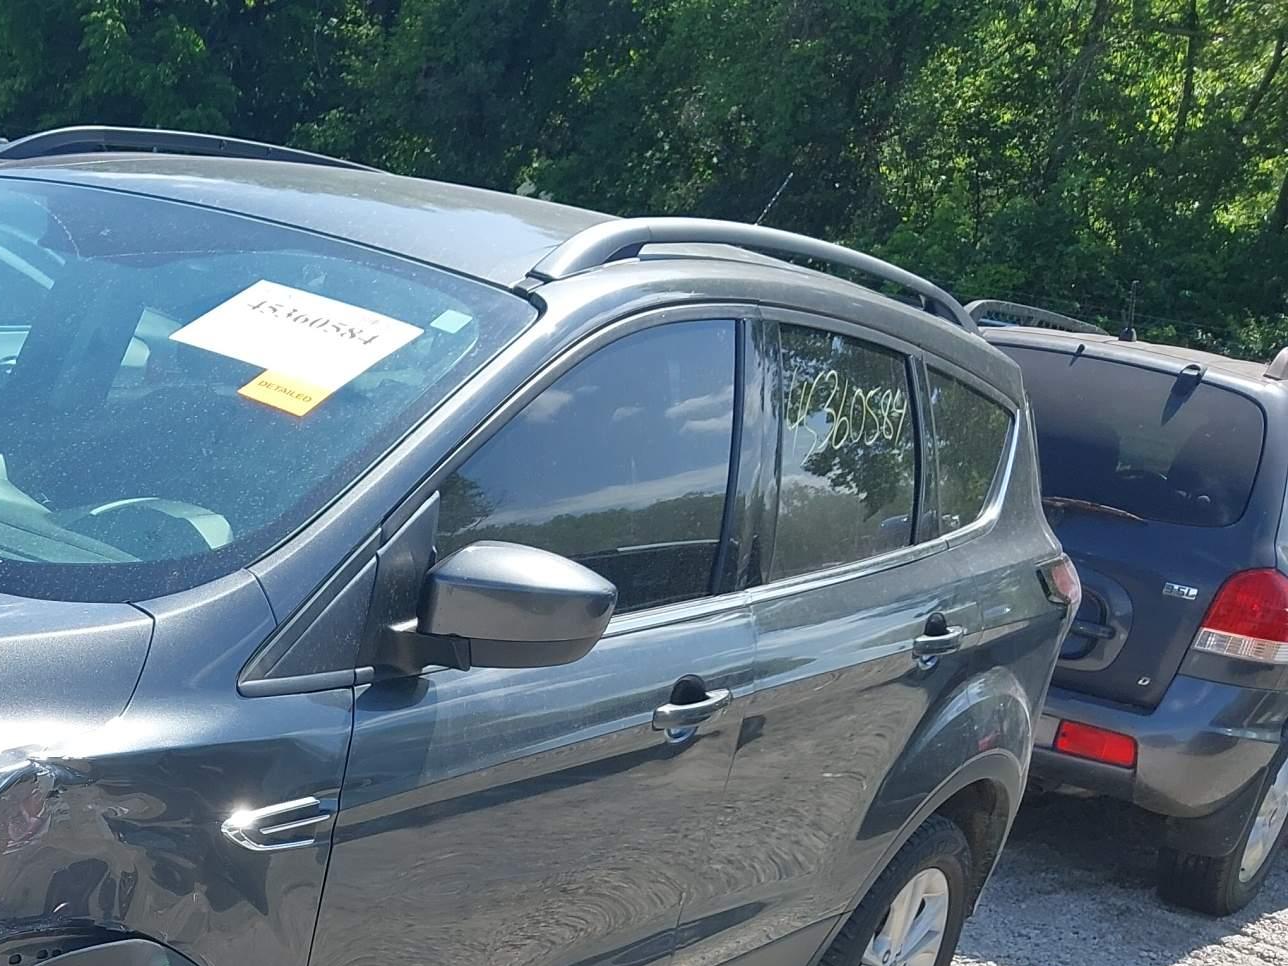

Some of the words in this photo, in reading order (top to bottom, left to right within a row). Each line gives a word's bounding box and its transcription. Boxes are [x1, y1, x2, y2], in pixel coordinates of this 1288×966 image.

[247, 300, 380, 345] 45360584
[257, 379, 313, 403] DETAILED
[786, 366, 908, 466] 45360584
